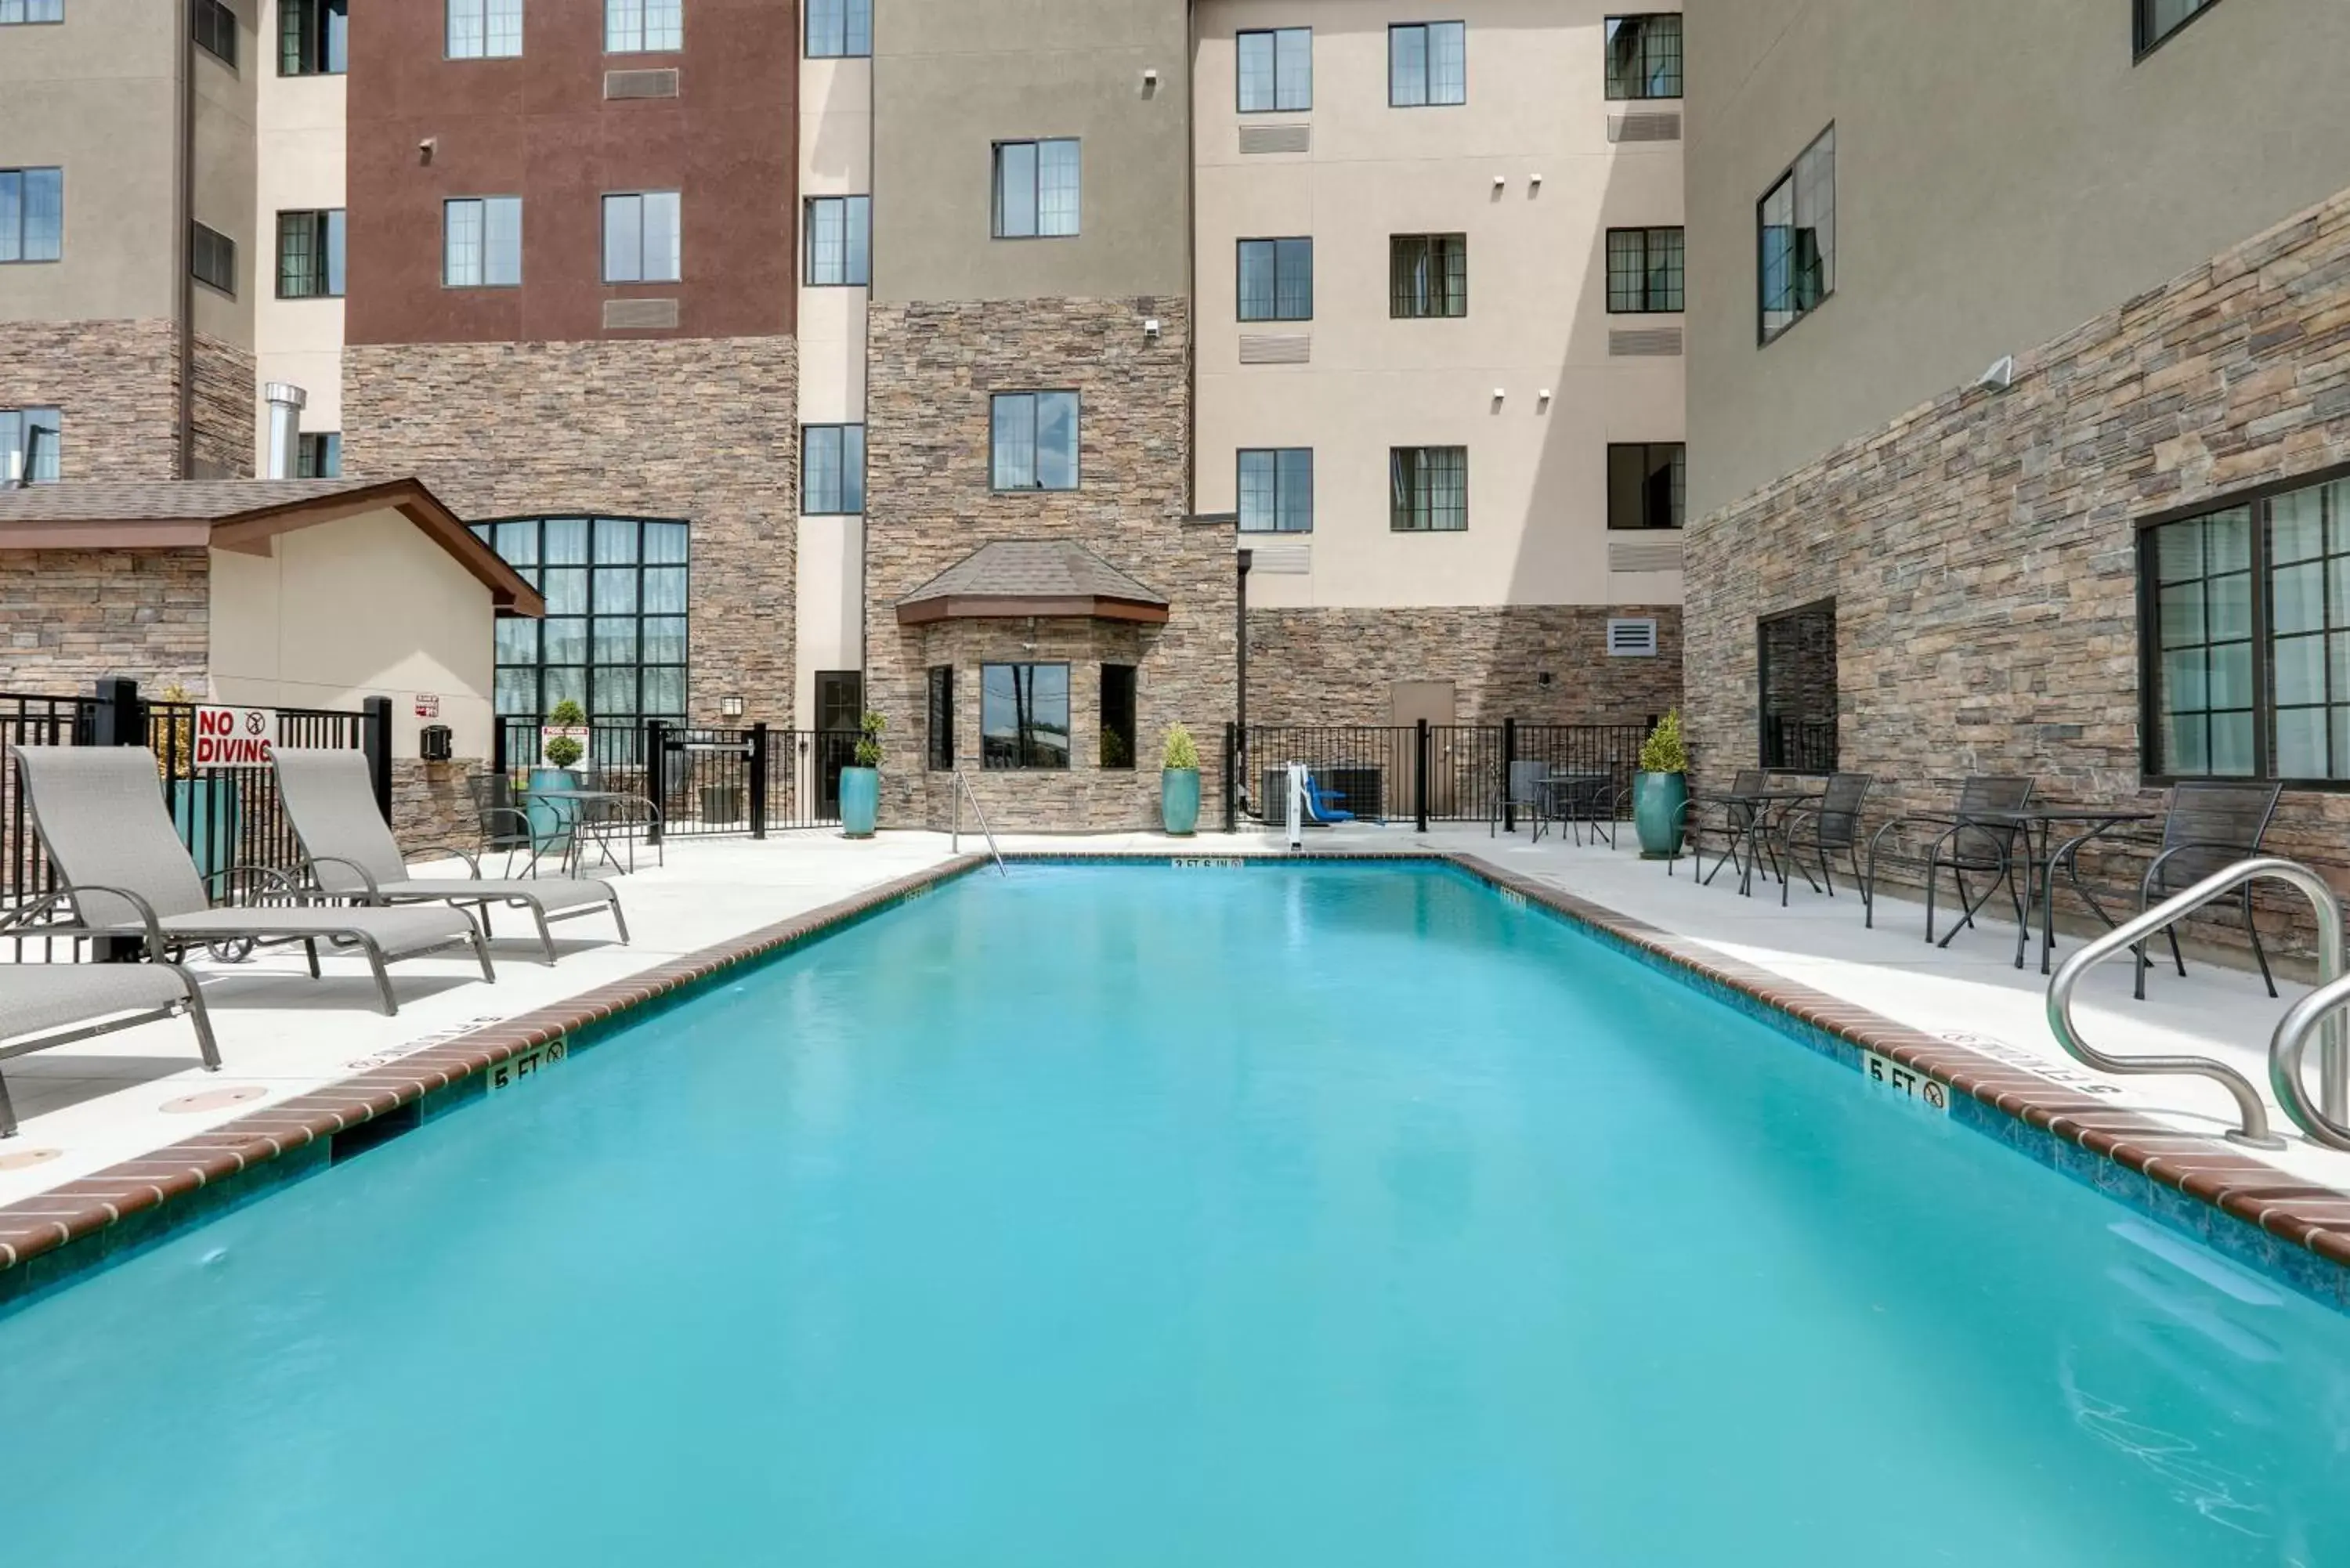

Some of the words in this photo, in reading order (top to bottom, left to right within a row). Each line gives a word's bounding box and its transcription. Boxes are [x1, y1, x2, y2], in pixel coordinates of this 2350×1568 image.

[200, 710, 234, 735] NO
[197, 738, 273, 763] DIVING
[494, 1066, 509, 1089] 5
[518, 1052, 540, 1080] FT
[1870, 1057, 1883, 1082] 5
[1892, 1068, 1917, 1097] FT
